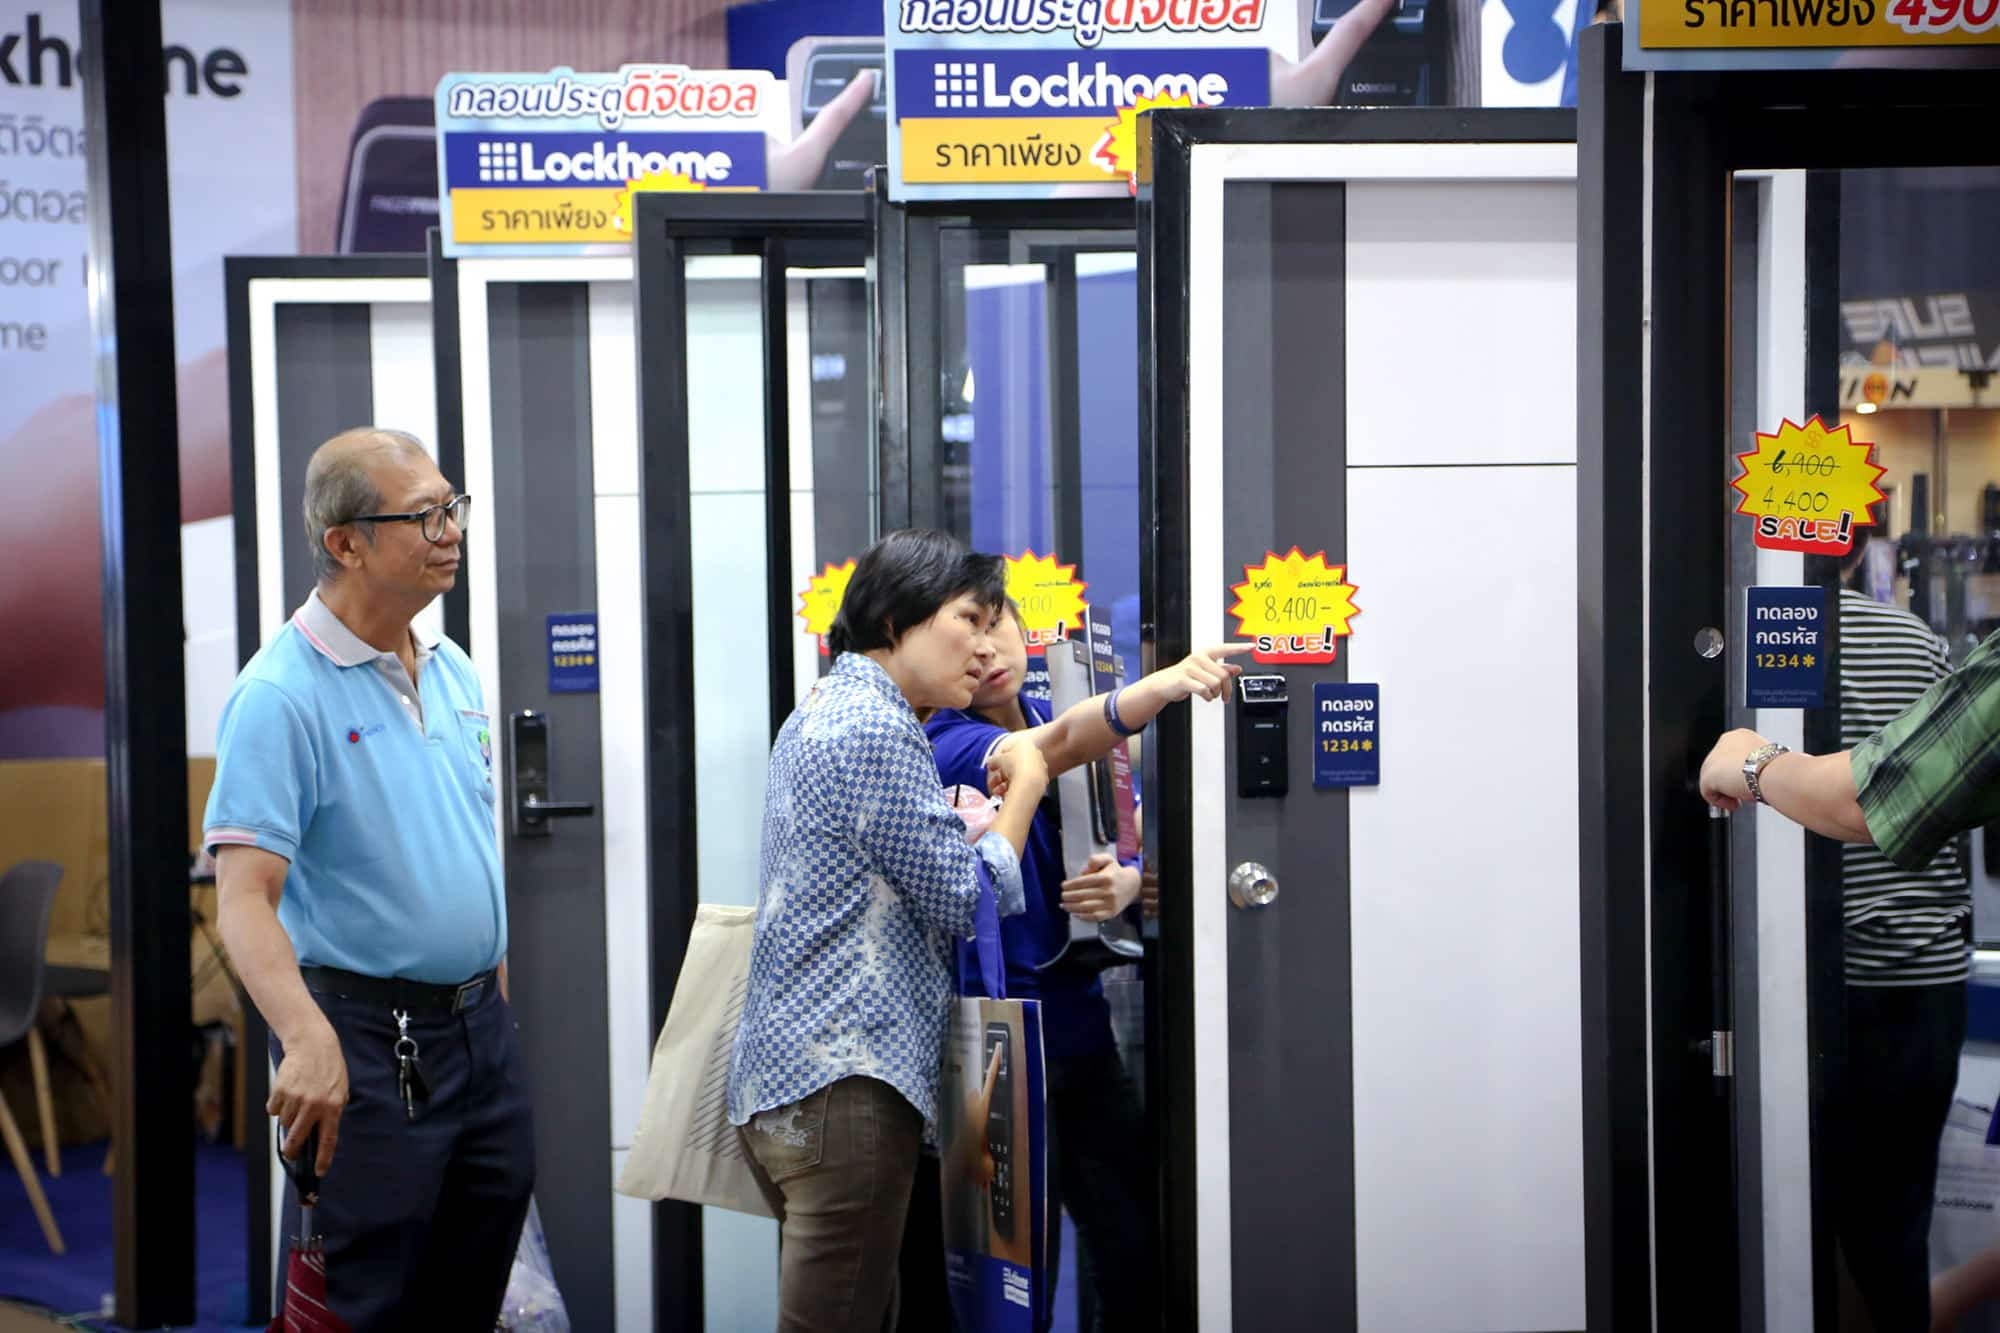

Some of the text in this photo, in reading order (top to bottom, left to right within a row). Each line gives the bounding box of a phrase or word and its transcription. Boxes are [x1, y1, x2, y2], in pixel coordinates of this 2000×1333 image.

[983, 61, 1228, 107] Lockhome
[521, 141, 732, 181] Lockhome
[935, 134, 1081, 167] ราคาเพียง
[481, 203, 607, 231] ราคาเพียง
[1759, 511, 1851, 542] SALE!
[1756, 607, 1819, 620] ทดลอง
[1257, 626, 1332, 652] SALE!
[1756, 626, 1819, 645] กดรหัส
[1321, 700, 1375, 712] ทดลอง
[1321, 715, 1375, 733] กดรหัส
